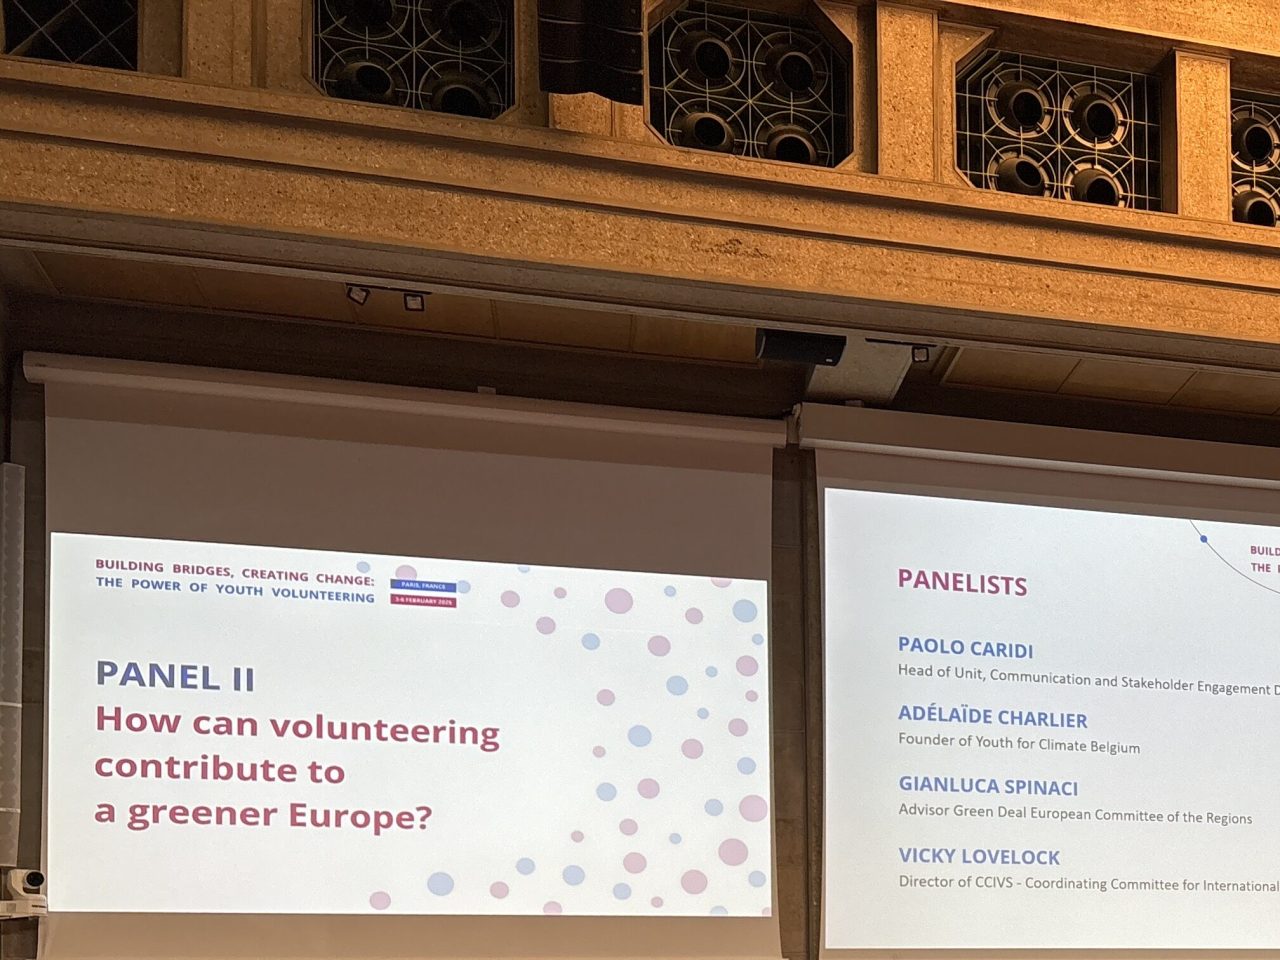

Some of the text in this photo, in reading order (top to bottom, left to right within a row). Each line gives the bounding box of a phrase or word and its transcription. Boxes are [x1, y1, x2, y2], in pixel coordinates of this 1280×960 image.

[96, 559, 374, 586] BUILDING BRIDGES, CREATING CHANGE:
[1251, 563, 1271, 572] THE
[96, 577, 374, 603] THE POWER OF YOUTH VOLUNTEERING
[899, 569, 1027, 596] PANELISTS
[899, 637, 1032, 658] PAOLO CARIDI
[98, 661, 253, 691] PANEL II
[899, 664, 932, 676] Head
[937, 666, 951, 677] of
[955, 667, 986, 682] Unit,
[990, 669, 1090, 685] Communication
[1095, 676, 1117, 686] and
[1122, 677, 1194, 690] Stakeholder
[1198, 681, 1270, 695] Engagement
[898, 703, 1087, 728] ADÉLAÏDE CHARLIER
[97, 706, 499, 752] How can volunteering
[899, 732, 1140, 755] Founder of Youth for Climate Belgium
[95, 754, 344, 784] contribute to
[900, 776, 1077, 796] GIANLUCA SPINACI
[95, 803, 432, 836] a greener Europe?
[899, 803, 1252, 826] Advisor Green Deal European Committee of the Regions
[899, 848, 1060, 865] VICKY LOVELOCK
[900, 875, 954, 887] Director
[958, 876, 972, 887] of
[976, 876, 1013, 888] CCIVS
[1026, 877, 1107, 892] Coordinating
[1111, 879, 1179, 890] Committee
[1183, 879, 1200, 890] for
[1204, 880, 1279, 891] International
